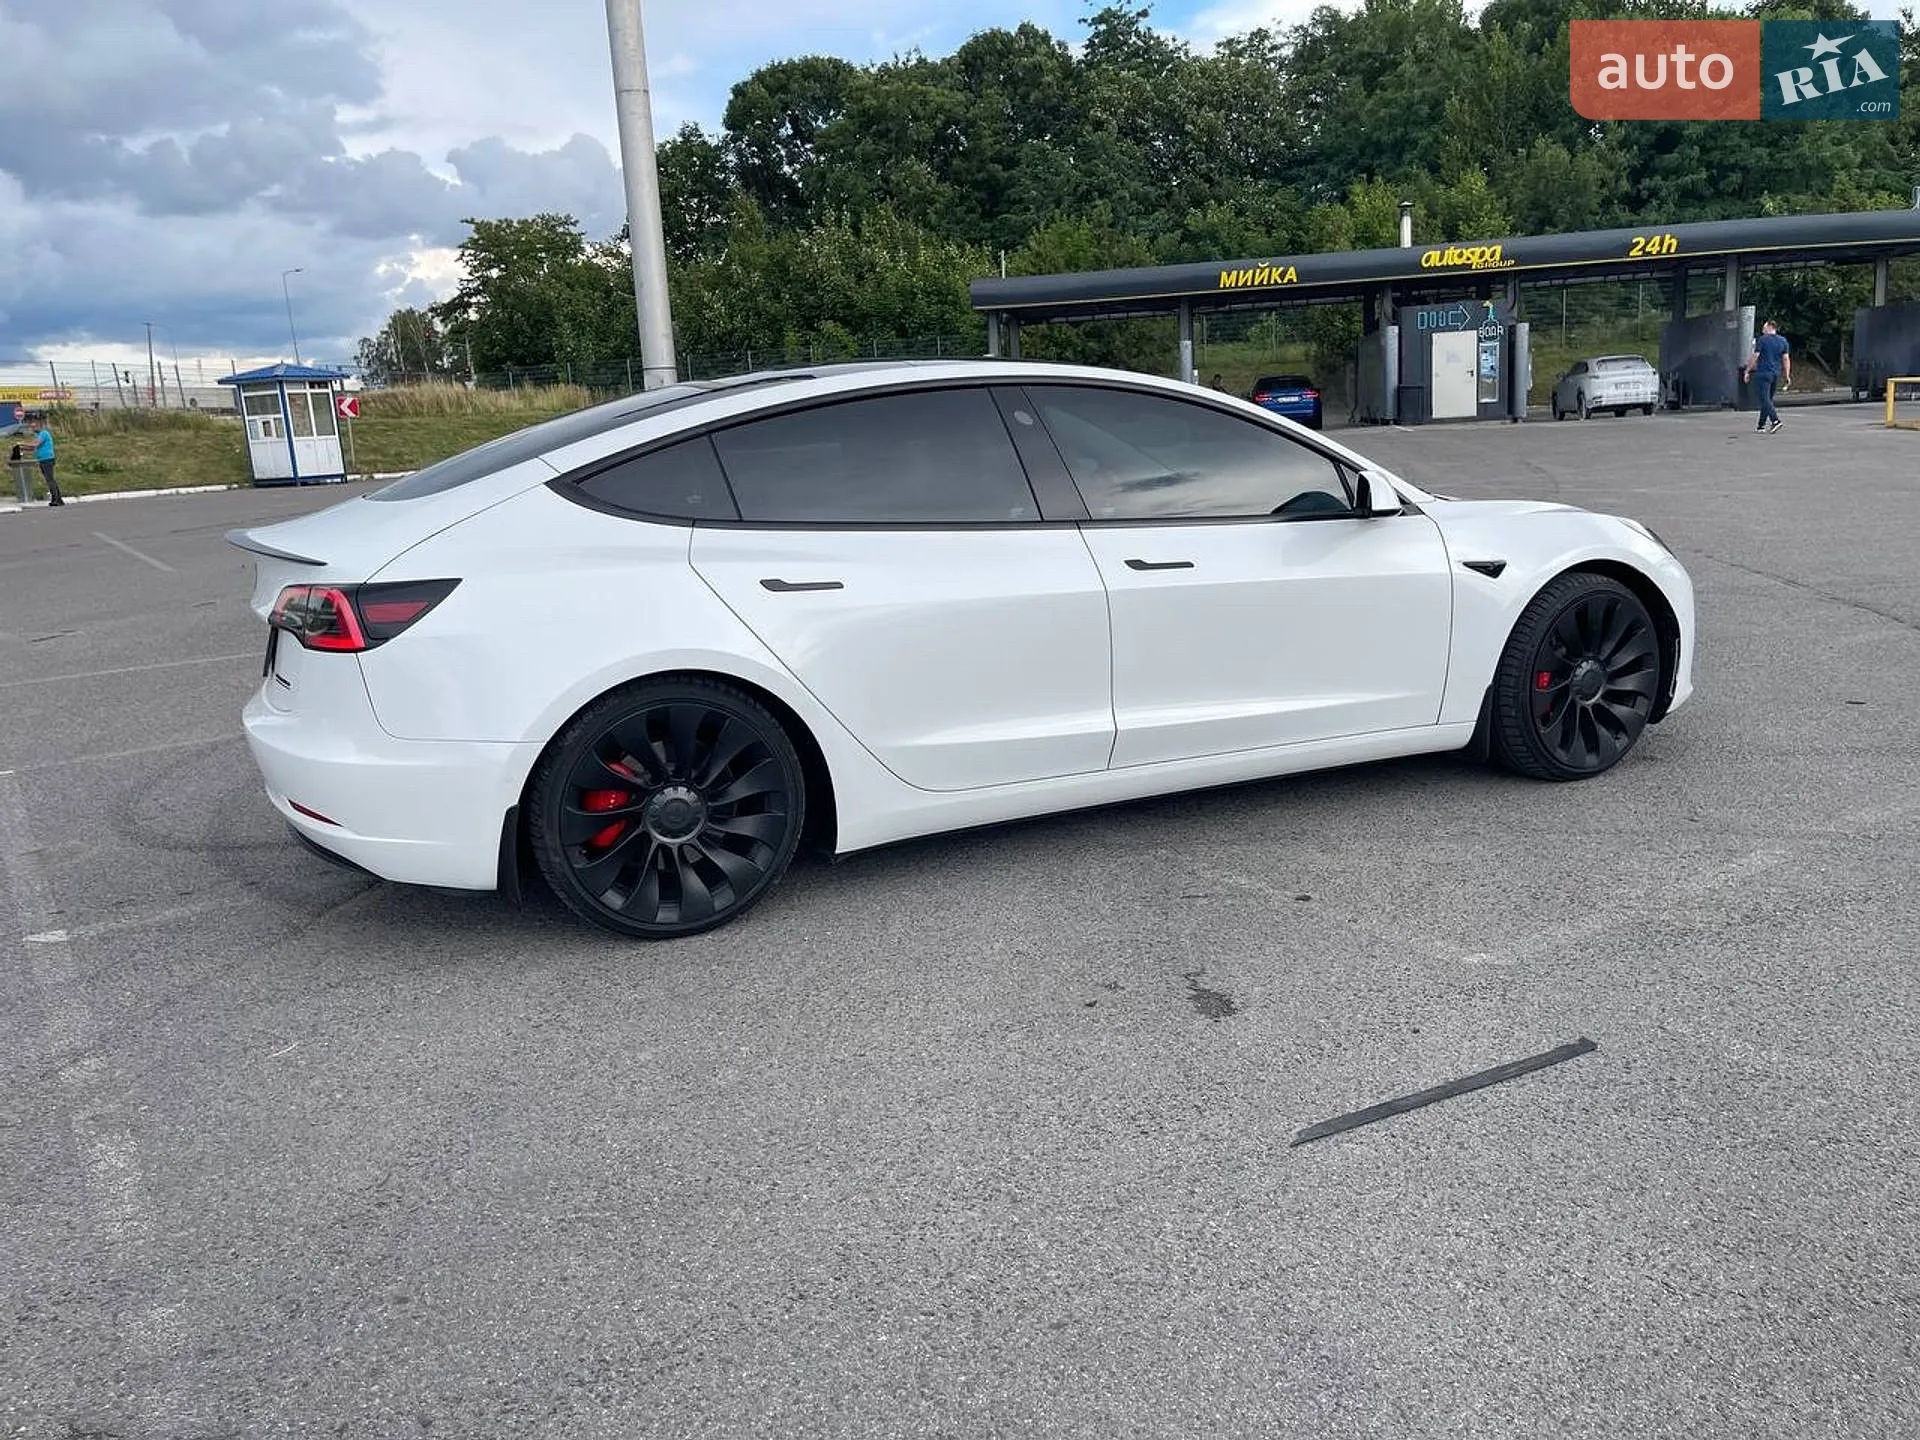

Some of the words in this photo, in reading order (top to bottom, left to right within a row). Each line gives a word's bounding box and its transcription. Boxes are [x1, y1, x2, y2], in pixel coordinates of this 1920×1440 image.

[1421, 244, 1502, 268] autospa
[1629, 233, 1677, 256] 24h
[1219, 261, 1298, 288] МИЙКА
